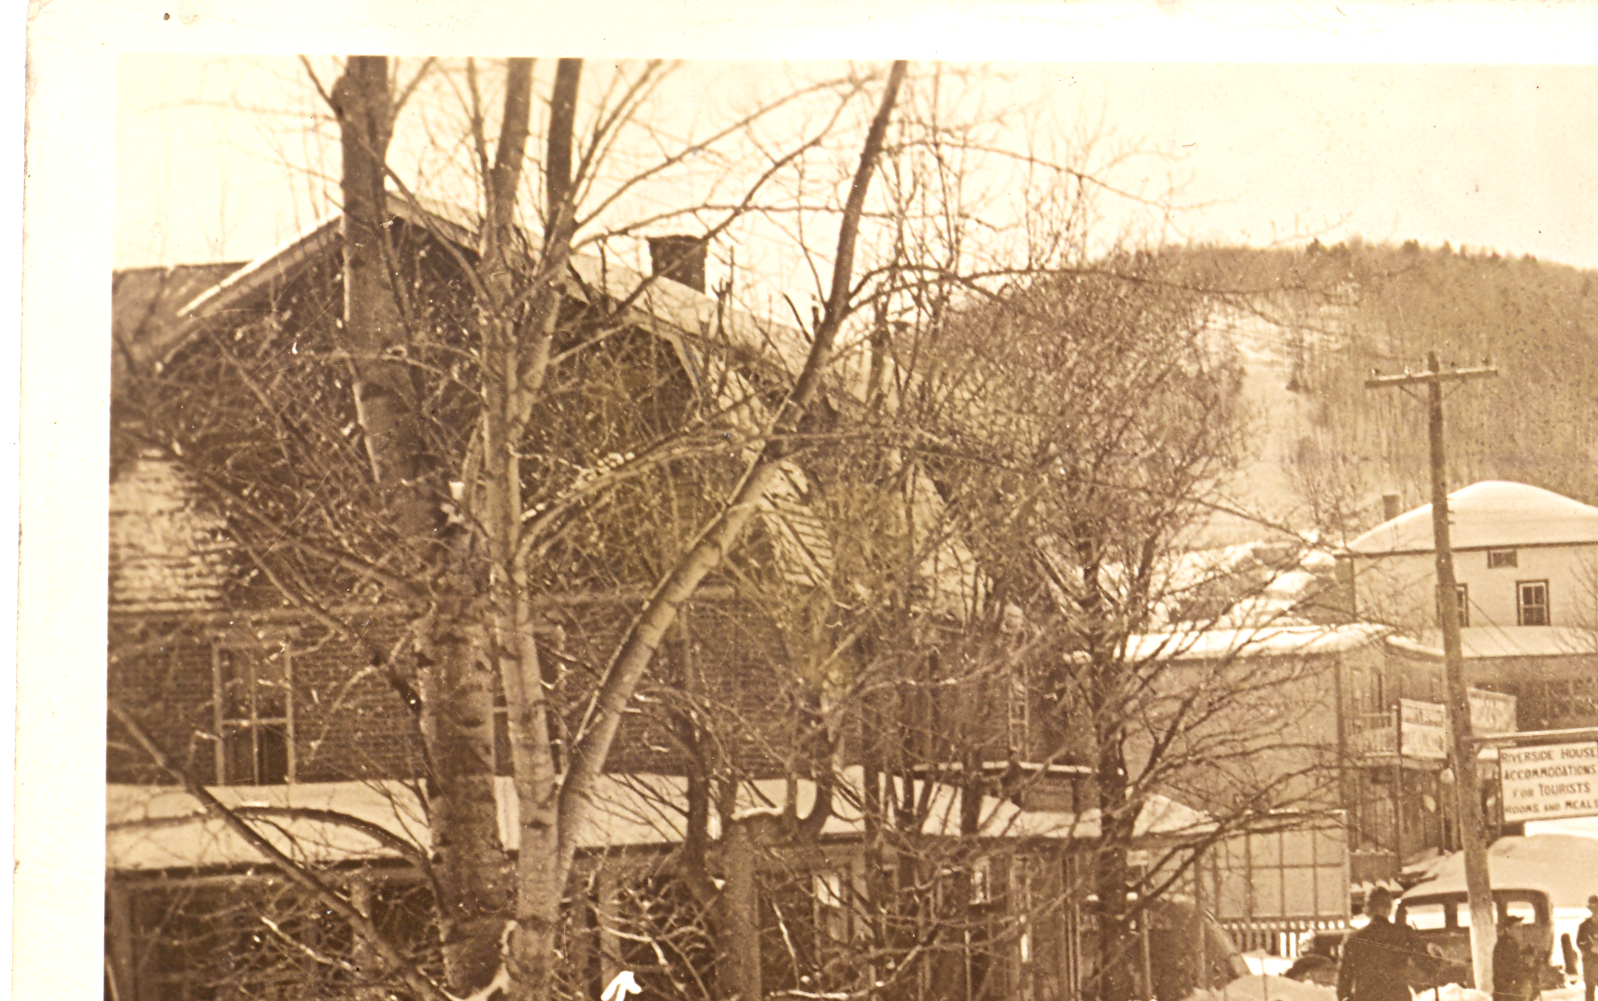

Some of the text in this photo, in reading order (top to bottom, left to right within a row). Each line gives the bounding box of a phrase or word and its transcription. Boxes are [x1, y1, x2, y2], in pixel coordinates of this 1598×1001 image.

[1501, 747, 1597, 763] RIVERSIDE HOUSE
[1504, 764, 1597, 780] ACCOMMODATIONS
[1513, 781, 1591, 798] FOR TOURISTS
[1504, 803, 1540, 814] ROOMS
[1544, 803, 1560, 812] AND
